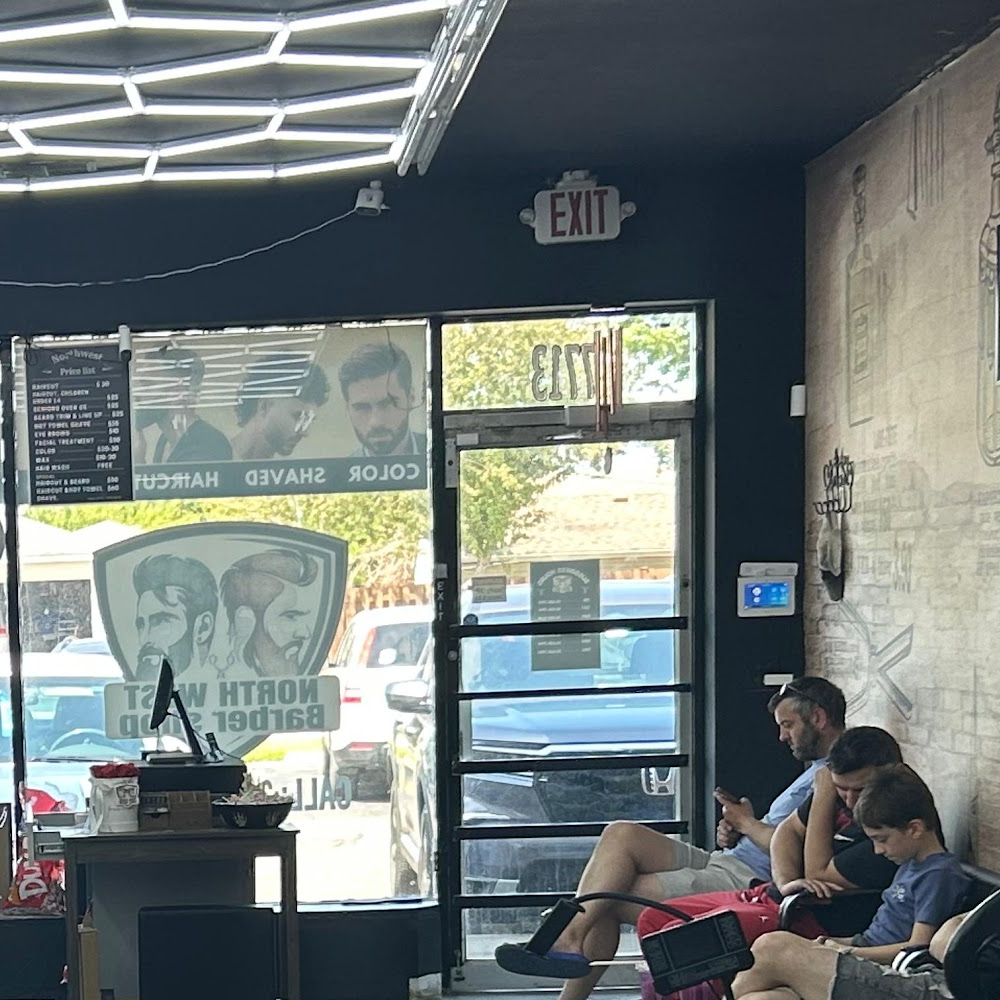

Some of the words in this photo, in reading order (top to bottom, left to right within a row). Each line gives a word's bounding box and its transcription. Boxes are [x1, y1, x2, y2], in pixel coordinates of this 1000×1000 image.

[550, 189, 608, 238] EXIT
[60, 367, 80, 376] Price
[82, 366, 96, 374] list
